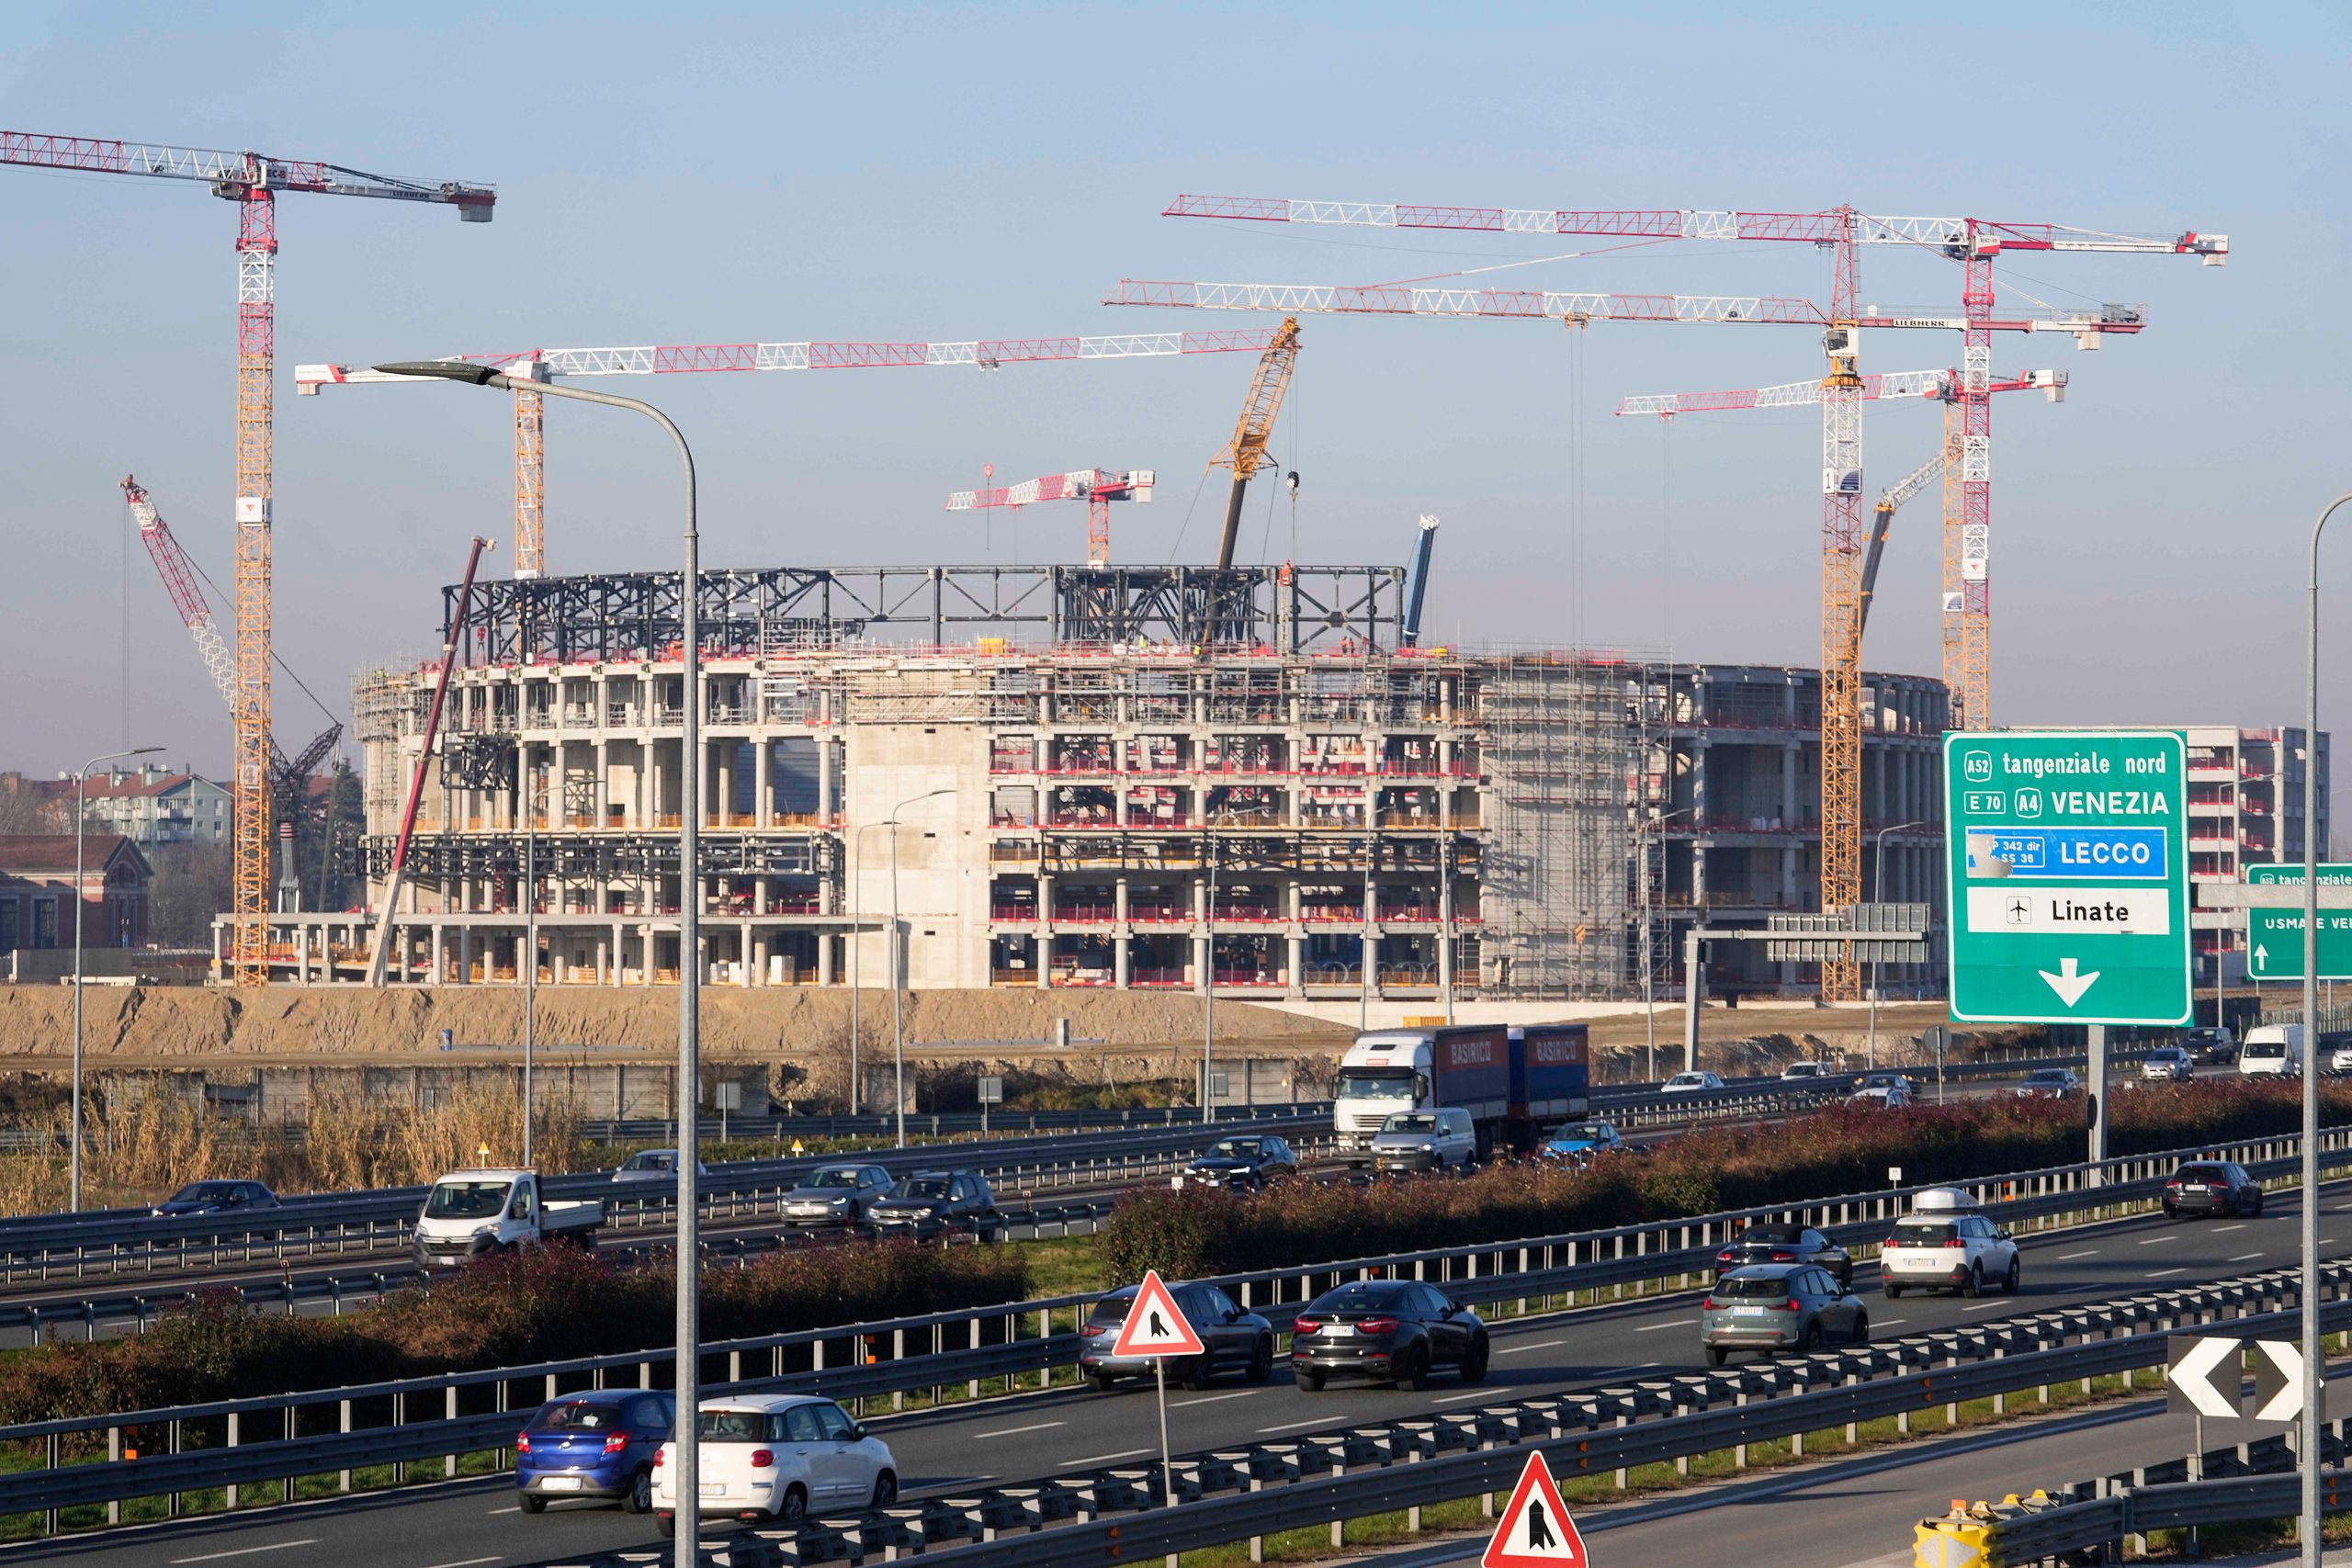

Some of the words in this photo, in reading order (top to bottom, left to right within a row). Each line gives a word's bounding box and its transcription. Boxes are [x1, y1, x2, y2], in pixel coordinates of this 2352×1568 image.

[1967, 760, 1989, 773] A52
[2003, 752, 2110, 778] tangenziale
[2125, 751, 2166, 774] nord
[245, 767, 255, 784] 4
[1970, 795, 1979, 810] E
[1986, 795, 2000, 810] 70
[2018, 795, 2039, 812] A4
[2051, 791, 2170, 815] VENEZIA
[2003, 841, 2023, 851] 342
[2026, 841, 2041, 851] dir
[2061, 842, 2151, 864] LECCO
[2020, 853, 2034, 863] 36
[2278, 874, 2352, 885] tannziale
[2052, 900, 2129, 921] Linate
[2265, 918, 2325, 929] USMAE
